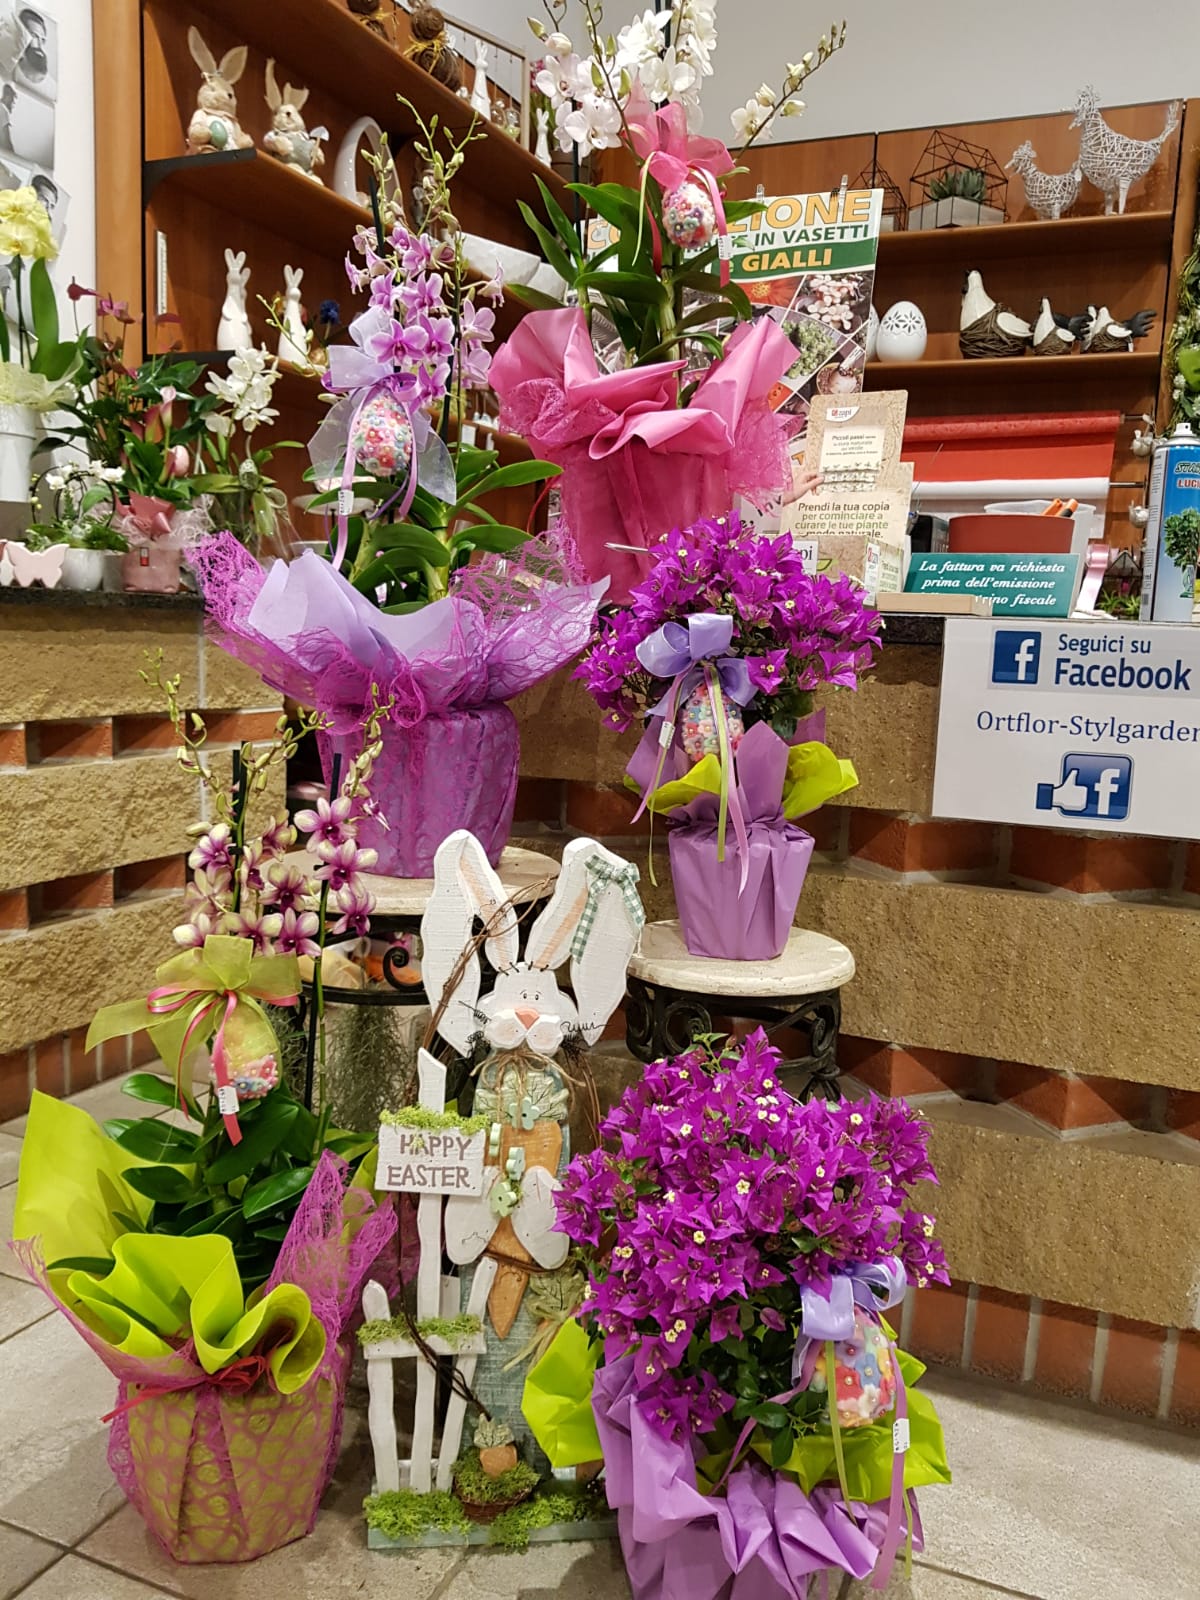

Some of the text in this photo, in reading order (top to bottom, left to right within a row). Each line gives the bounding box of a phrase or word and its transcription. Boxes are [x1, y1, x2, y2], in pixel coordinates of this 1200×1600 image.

[755, 231, 775, 246] IN
[783, 224, 869, 244] VASETTI
[741, 248, 832, 272] GIALLI
[798, 502, 890, 513] Prendi la tua copia
[802, 513, 817, 521] per
[819, 511, 876, 520] cominciare
[795, 520, 889, 532] curare le tue piante
[919, 560, 1065, 574] La fattura va richiesta
[921, 576, 1056, 589] prima dell'emissione
[1010, 593, 1057, 607] fiscale
[1058, 634, 1152, 656] Seguici su
[1054, 658, 1192, 690] Facebook
[400, 1133, 472, 1160] HAPPY
